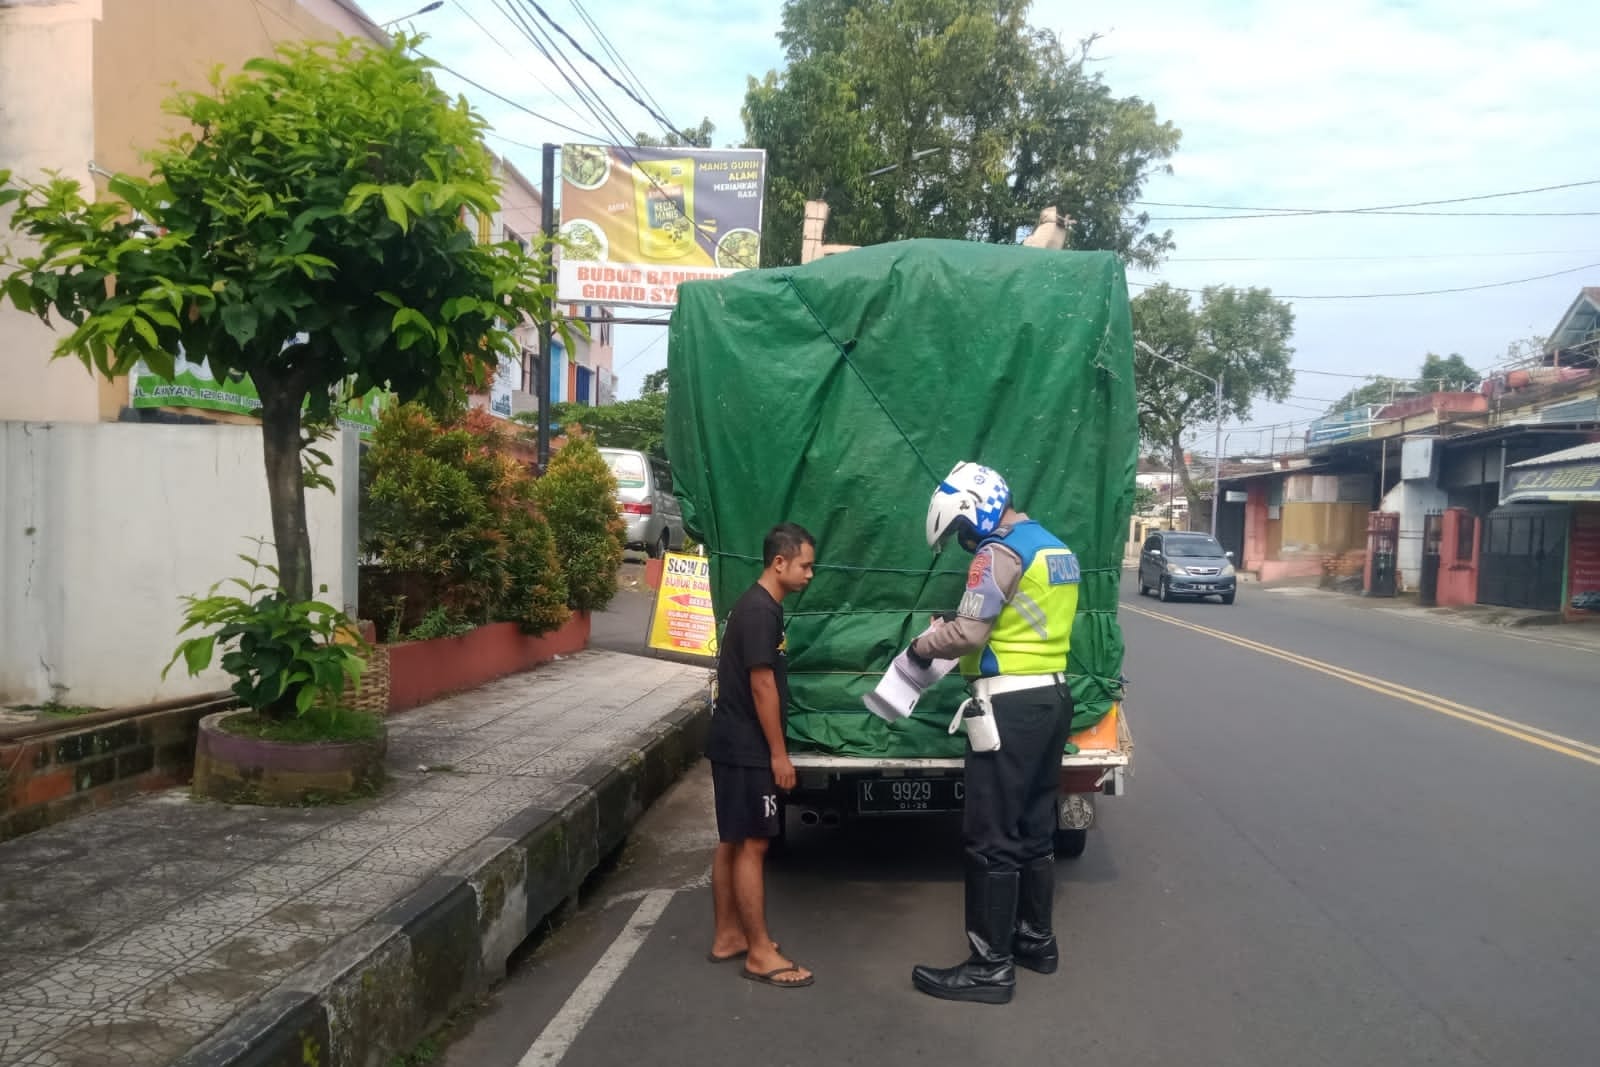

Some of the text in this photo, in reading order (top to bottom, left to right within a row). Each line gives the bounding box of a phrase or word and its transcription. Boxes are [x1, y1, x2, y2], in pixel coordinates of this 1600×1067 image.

[577, 266, 642, 283] BUBUR
[582, 284, 646, 301] GRAND
[667, 557, 697, 575] SLOW
[863, 782, 874, 801] K
[892, 782, 931, 801] 9929
